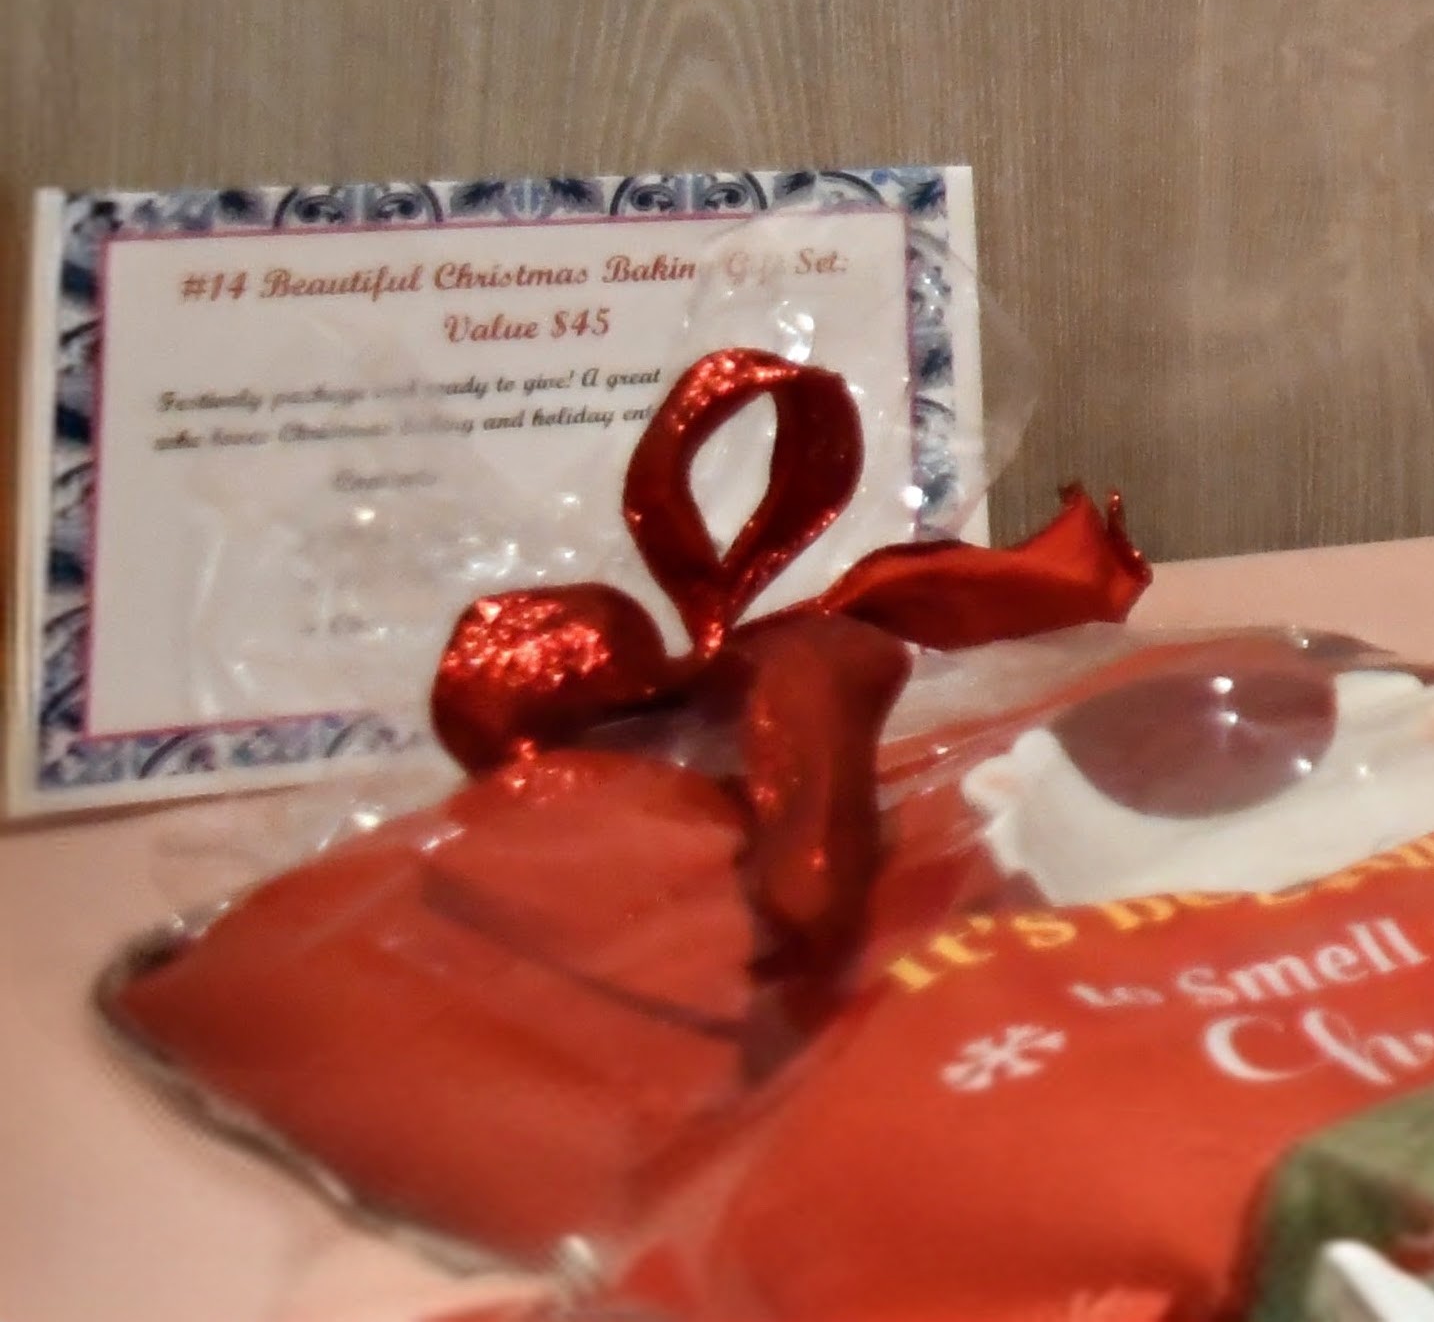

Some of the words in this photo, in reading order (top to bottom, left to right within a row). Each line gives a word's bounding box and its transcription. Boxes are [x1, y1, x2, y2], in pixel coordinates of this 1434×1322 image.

[182, 270, 248, 302] #14
[261, 264, 423, 302] Beautiful
[434, 261, 589, 290] Christmas
[601, 253, 706, 284] Bakin
[444, 311, 539, 343] Value
[550, 307, 611, 339] $45
[606, 367, 661, 391] great
[483, 412, 525, 432] and
[532, 407, 615, 430] holiday
